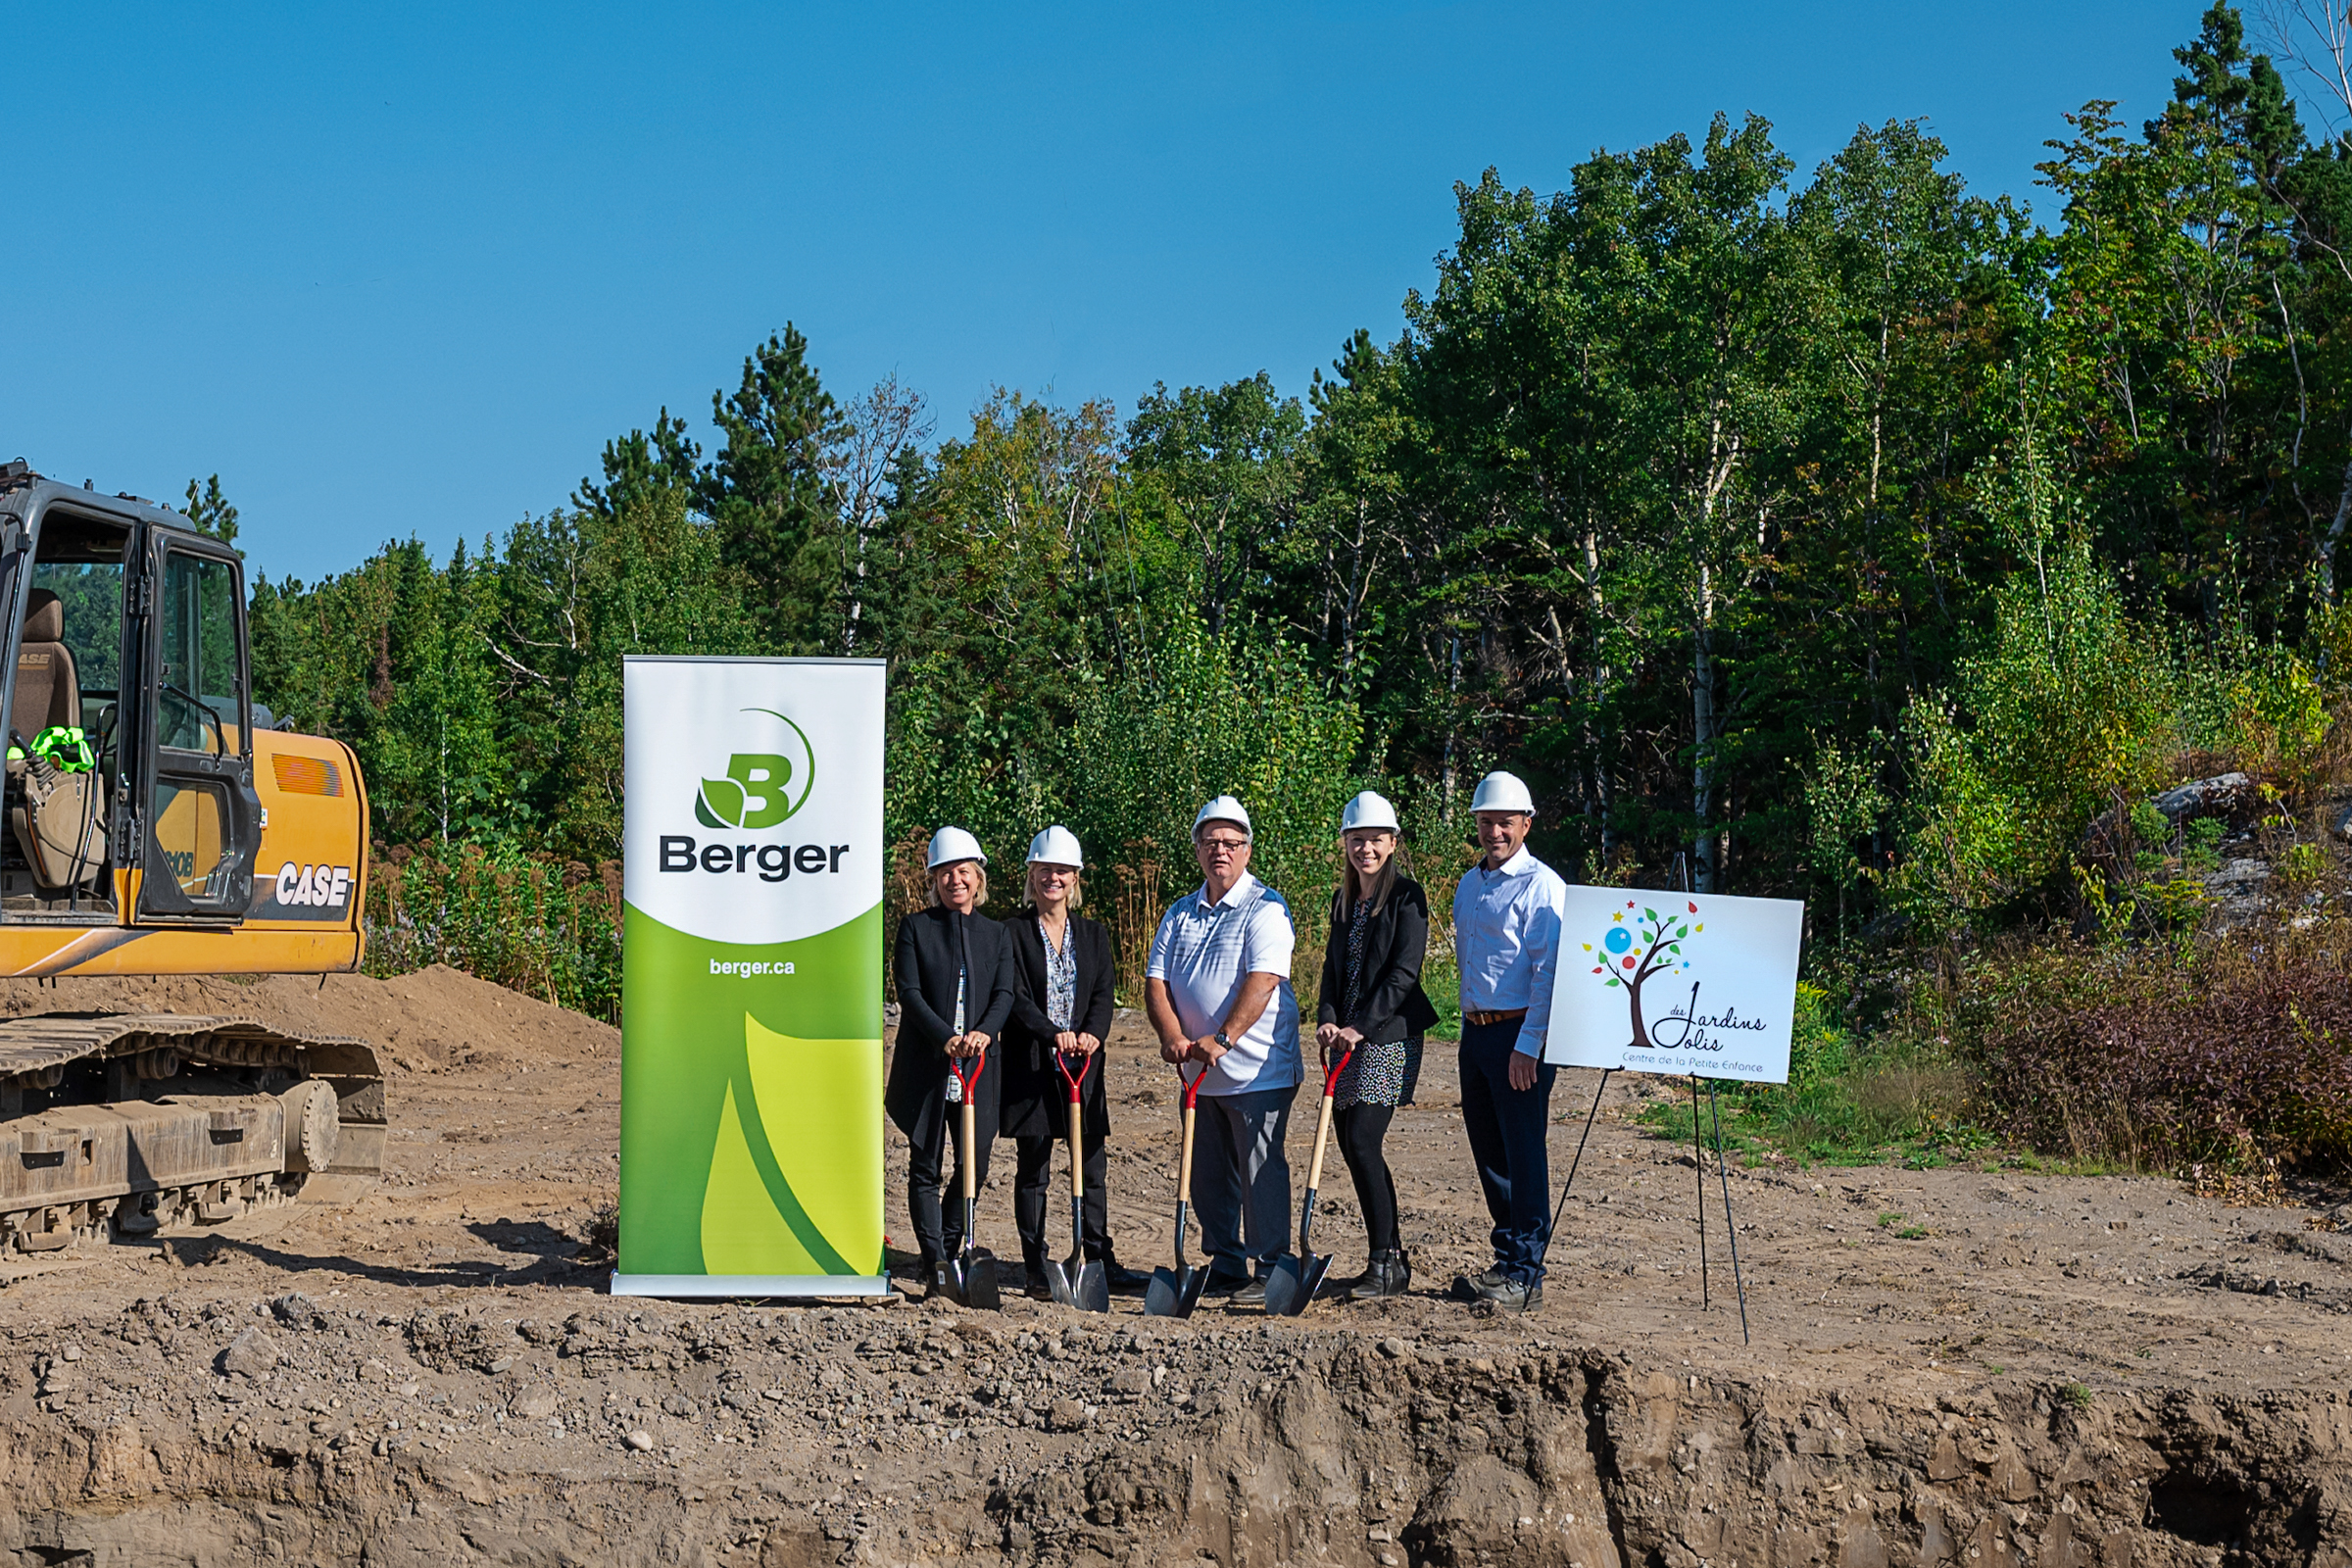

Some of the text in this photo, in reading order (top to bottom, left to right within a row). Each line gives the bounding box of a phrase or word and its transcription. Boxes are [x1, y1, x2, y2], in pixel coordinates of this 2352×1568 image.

[19, 653, 50, 664] ASE
[660, 835, 850, 883] Berger
[275, 861, 350, 906] CASE
[710, 958, 795, 978] berger.ca
[1652, 981, 1766, 1049] Jardins
[1670, 1004, 1687, 1016] des
[1622, 1052, 1763, 1073] Centre de la Petite Enfance
